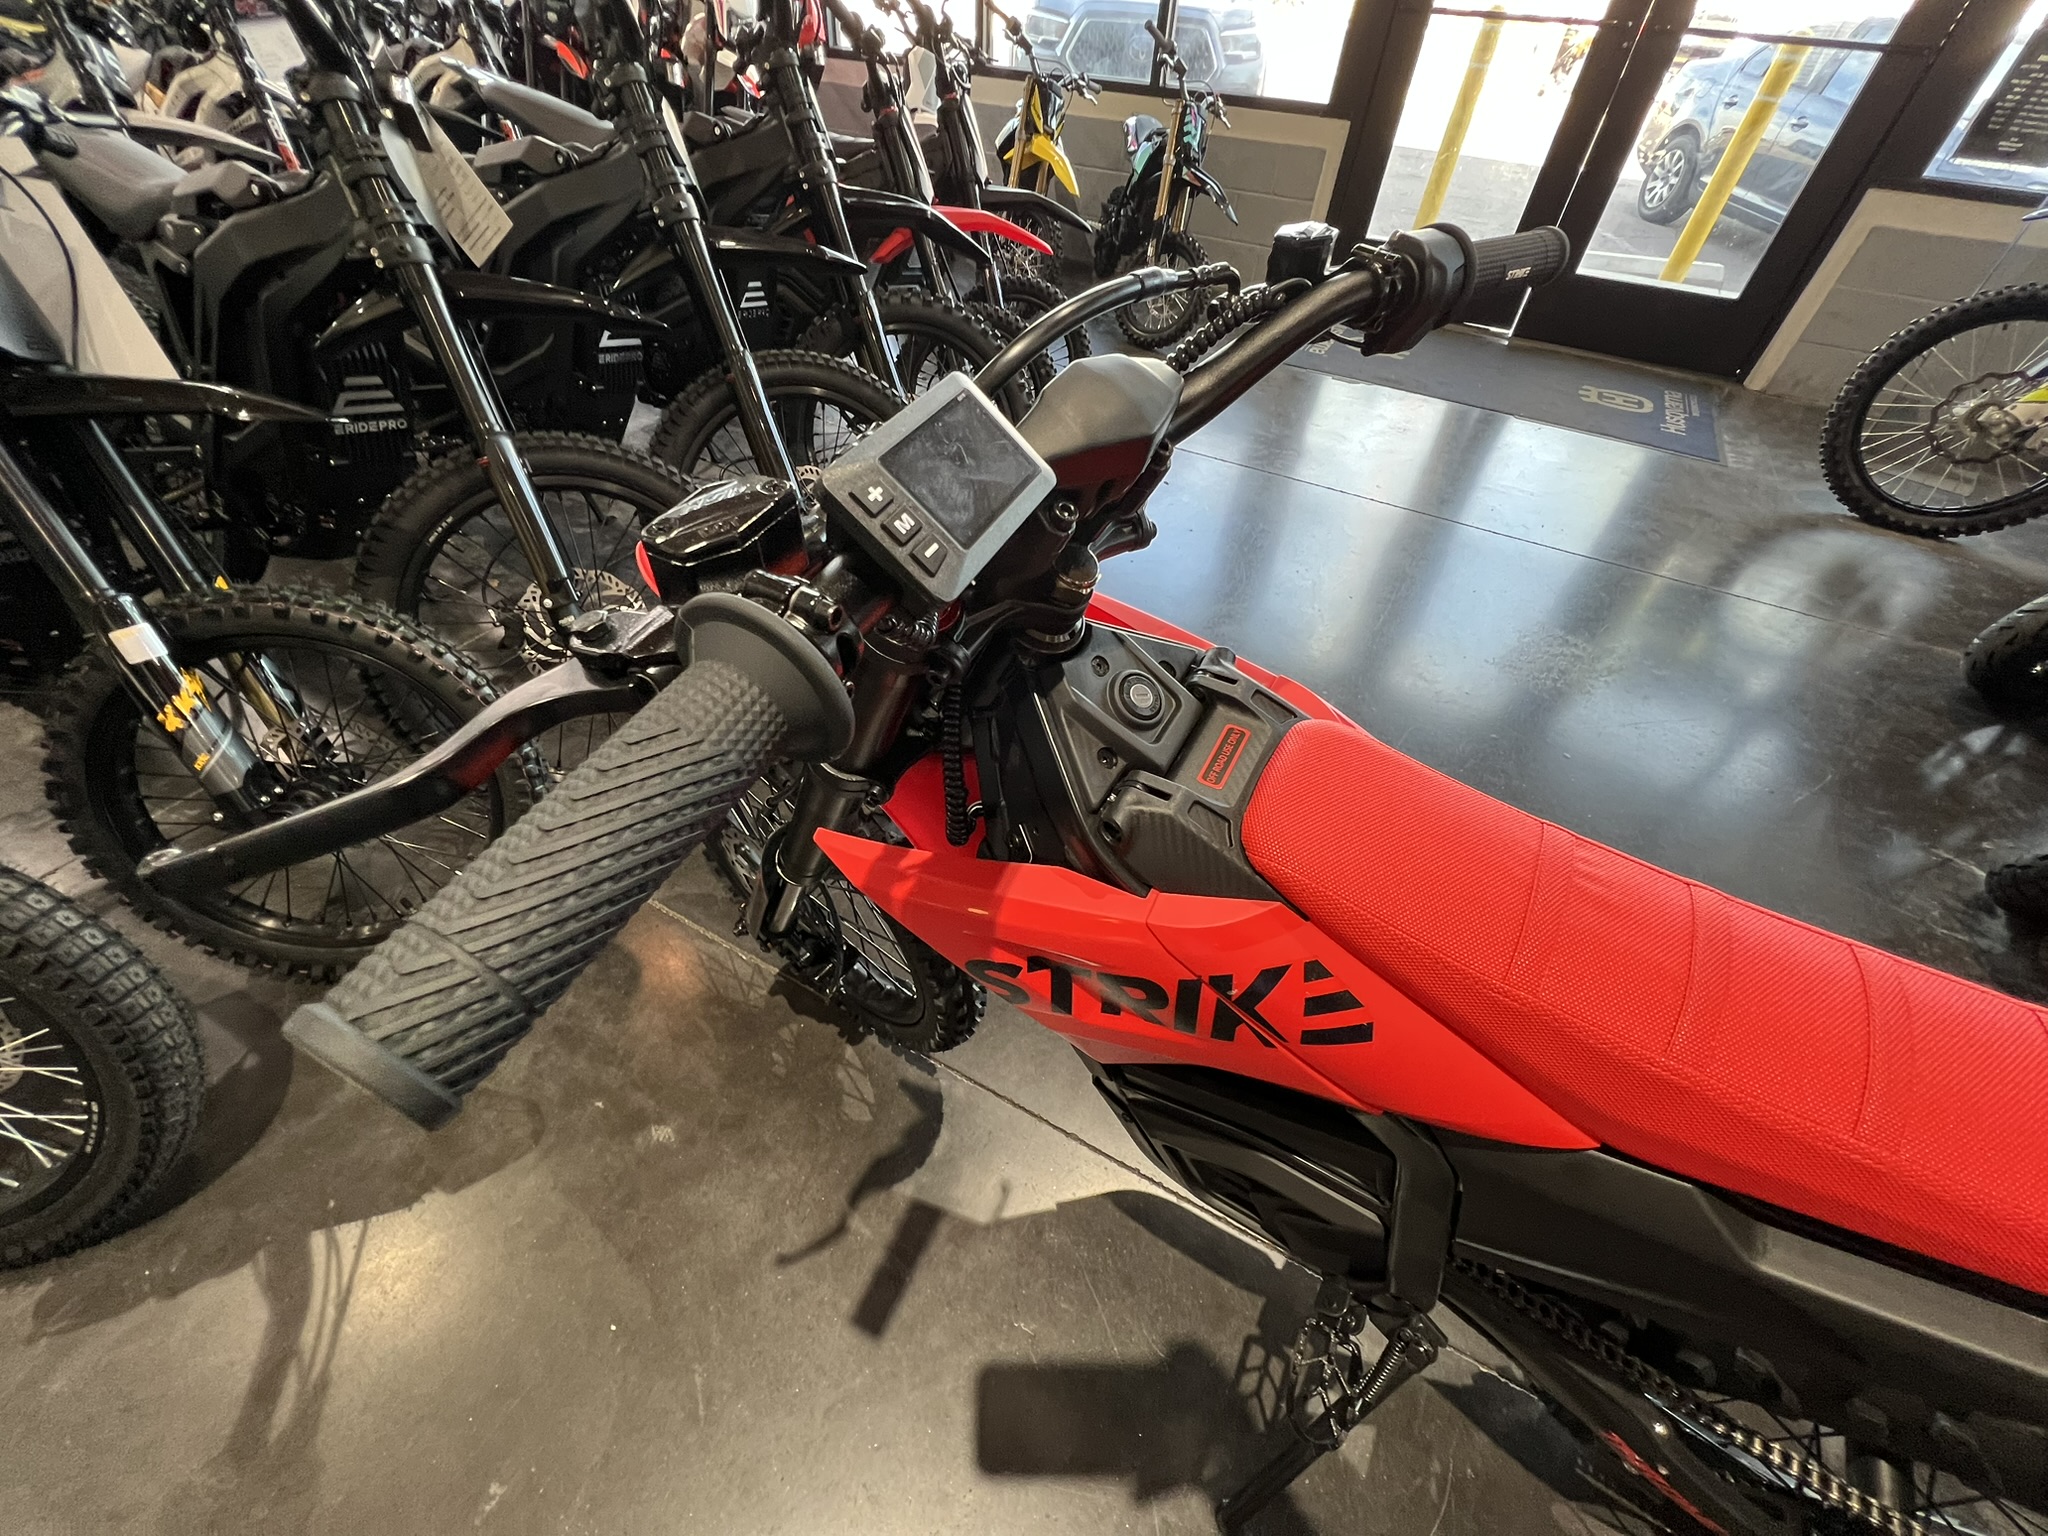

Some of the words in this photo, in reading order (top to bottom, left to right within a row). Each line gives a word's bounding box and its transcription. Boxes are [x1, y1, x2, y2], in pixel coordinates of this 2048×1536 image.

[893, 512, 916, 535] M
[1227, 728, 1241, 745] ONLY
[1221, 743, 1234, 756] USE
[1212, 754, 1228, 773] ROAD
[1206, 770, 1219, 784] OFF
[965, 955, 1375, 1049] STRIKE
